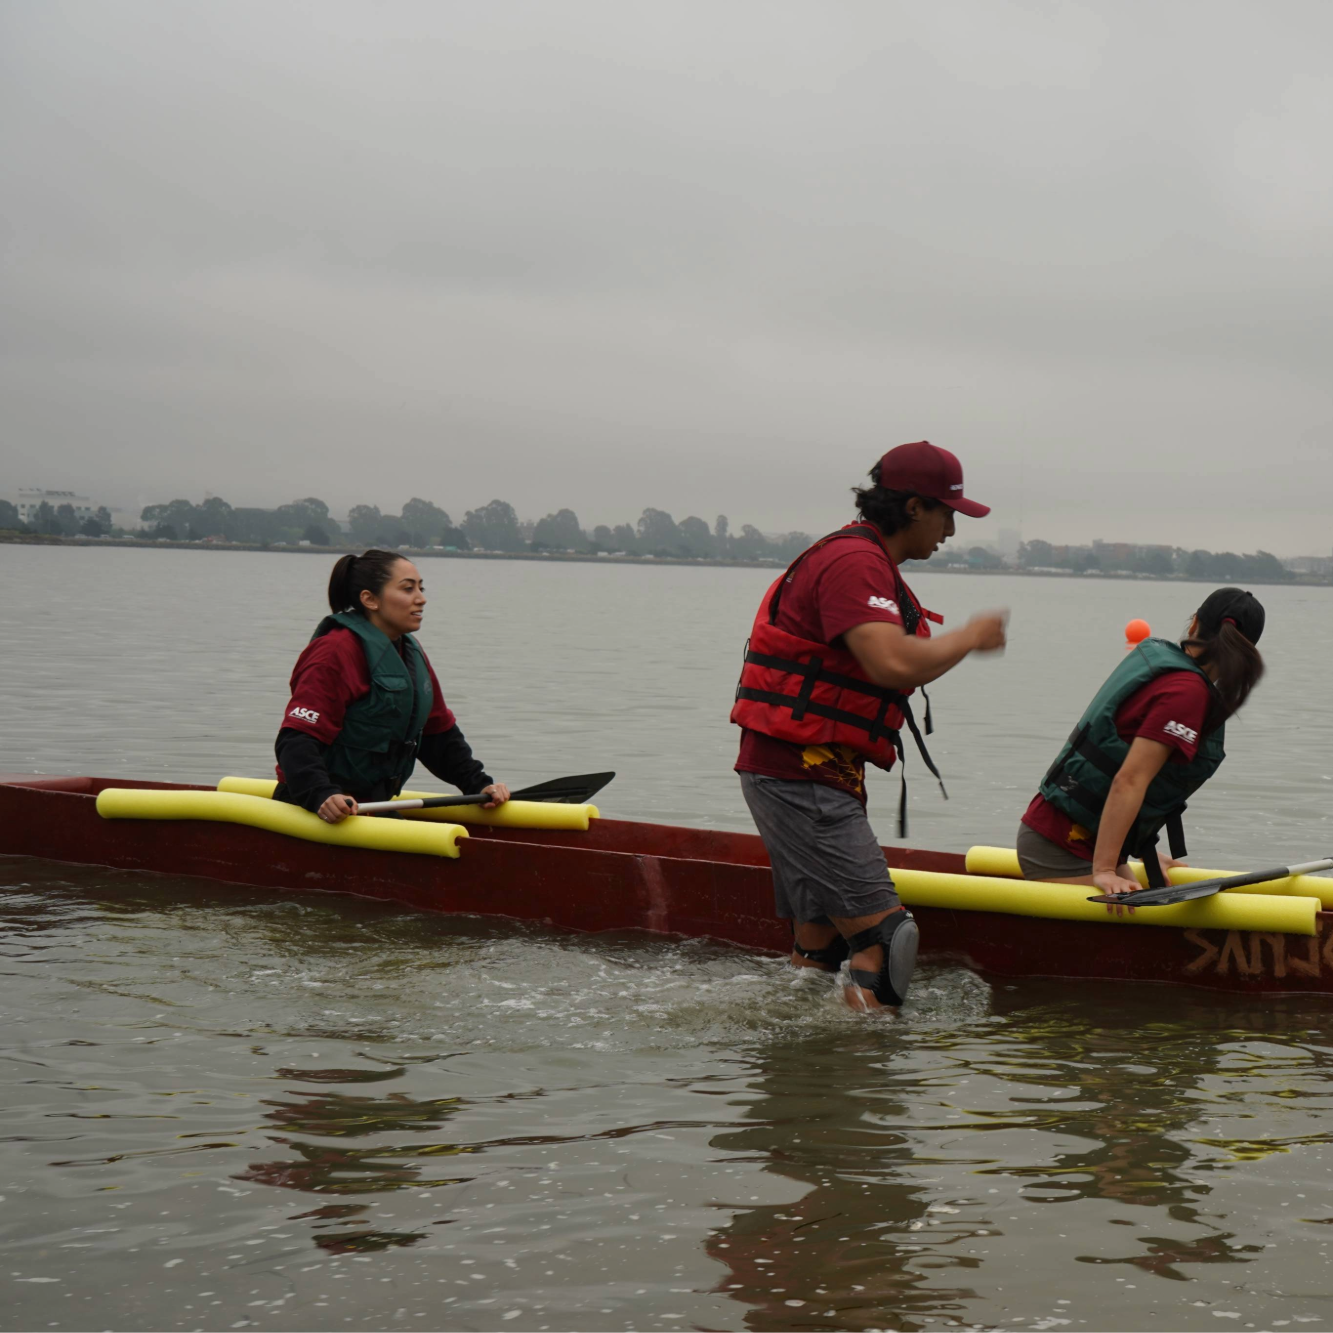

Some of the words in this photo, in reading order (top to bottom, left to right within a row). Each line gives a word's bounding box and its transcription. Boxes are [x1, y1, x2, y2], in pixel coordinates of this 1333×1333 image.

[289, 707, 320, 722] ASCE
[1163, 720, 1198, 742] ASCE
[1183, 928, 1287, 978] SAN
